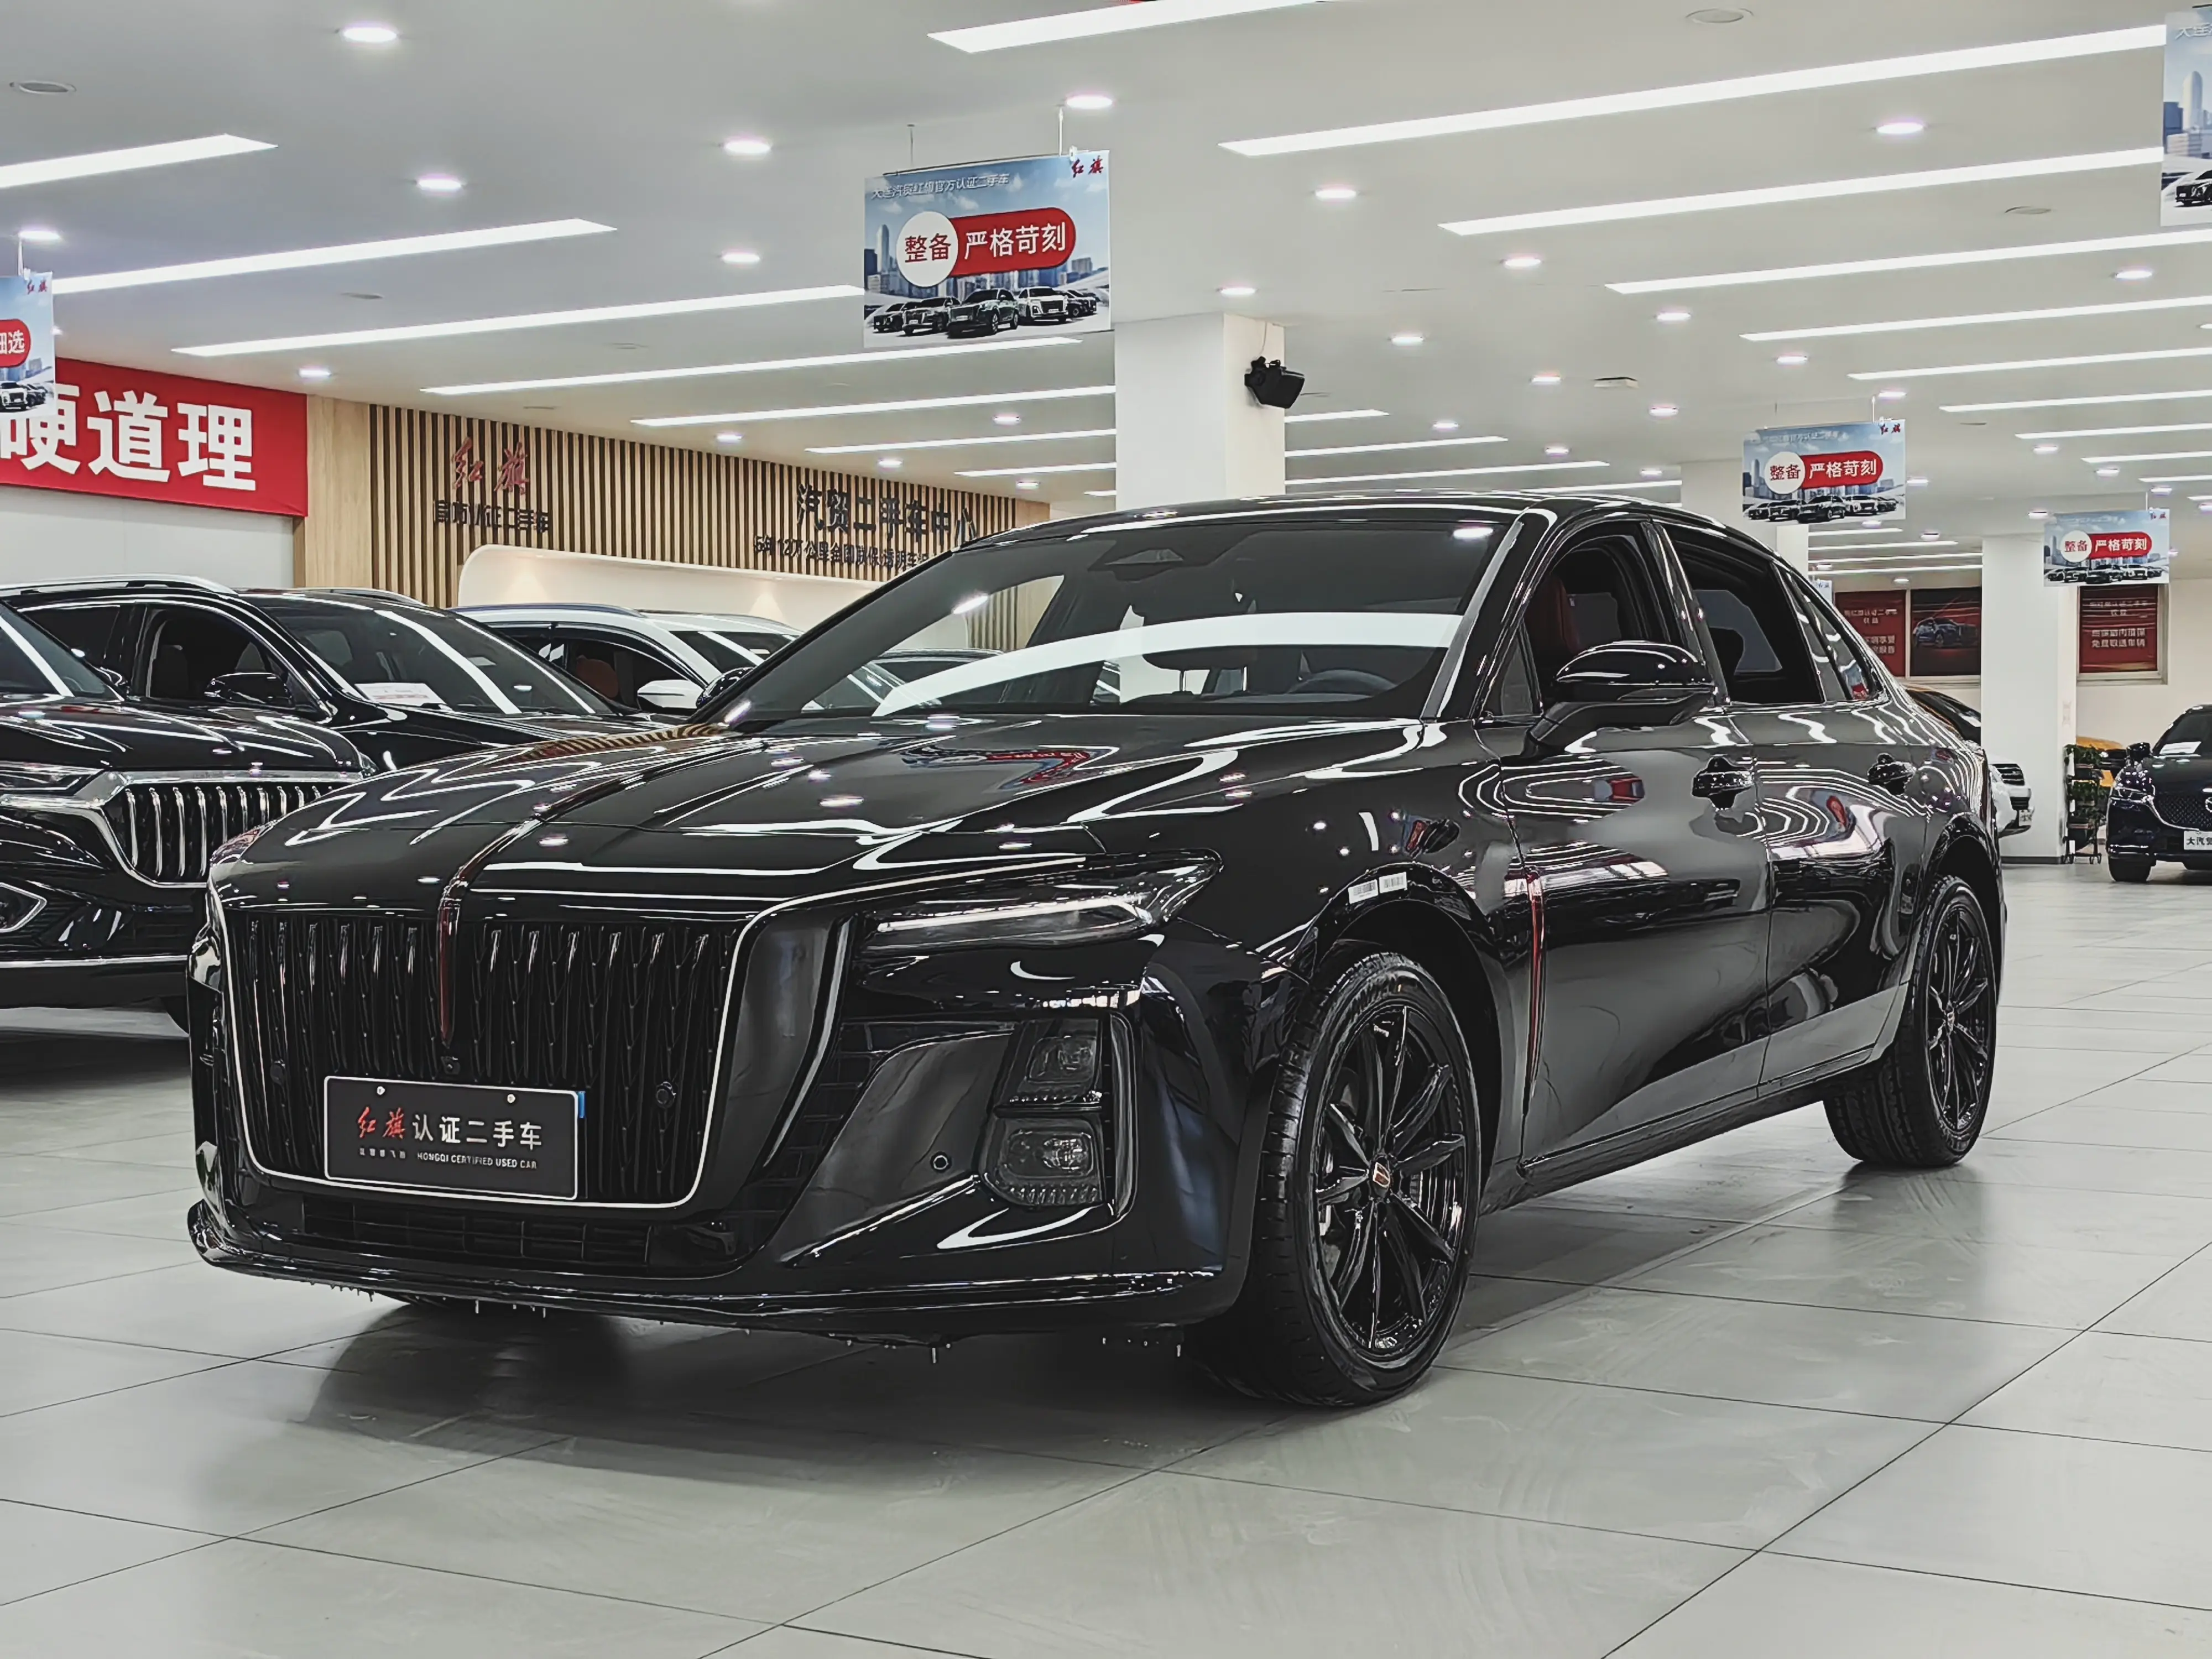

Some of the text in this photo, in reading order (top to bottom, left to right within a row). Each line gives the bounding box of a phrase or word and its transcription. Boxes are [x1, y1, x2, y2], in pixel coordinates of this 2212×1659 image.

[1071, 155, 1103, 178] 红旗
[905, 222, 1066, 263] 整备 严格苛刻
[1770, 459, 1876, 481] 整备 严格苛刻
[2095, 538, 2147, 552] 严格苛刻
[417, 1151, 449, 1162] HONGQI
[451, 1154, 493, 1166] CERTIFIED
[495, 1158, 518, 1168] USED
[520, 1160, 537, 1169] CAR
